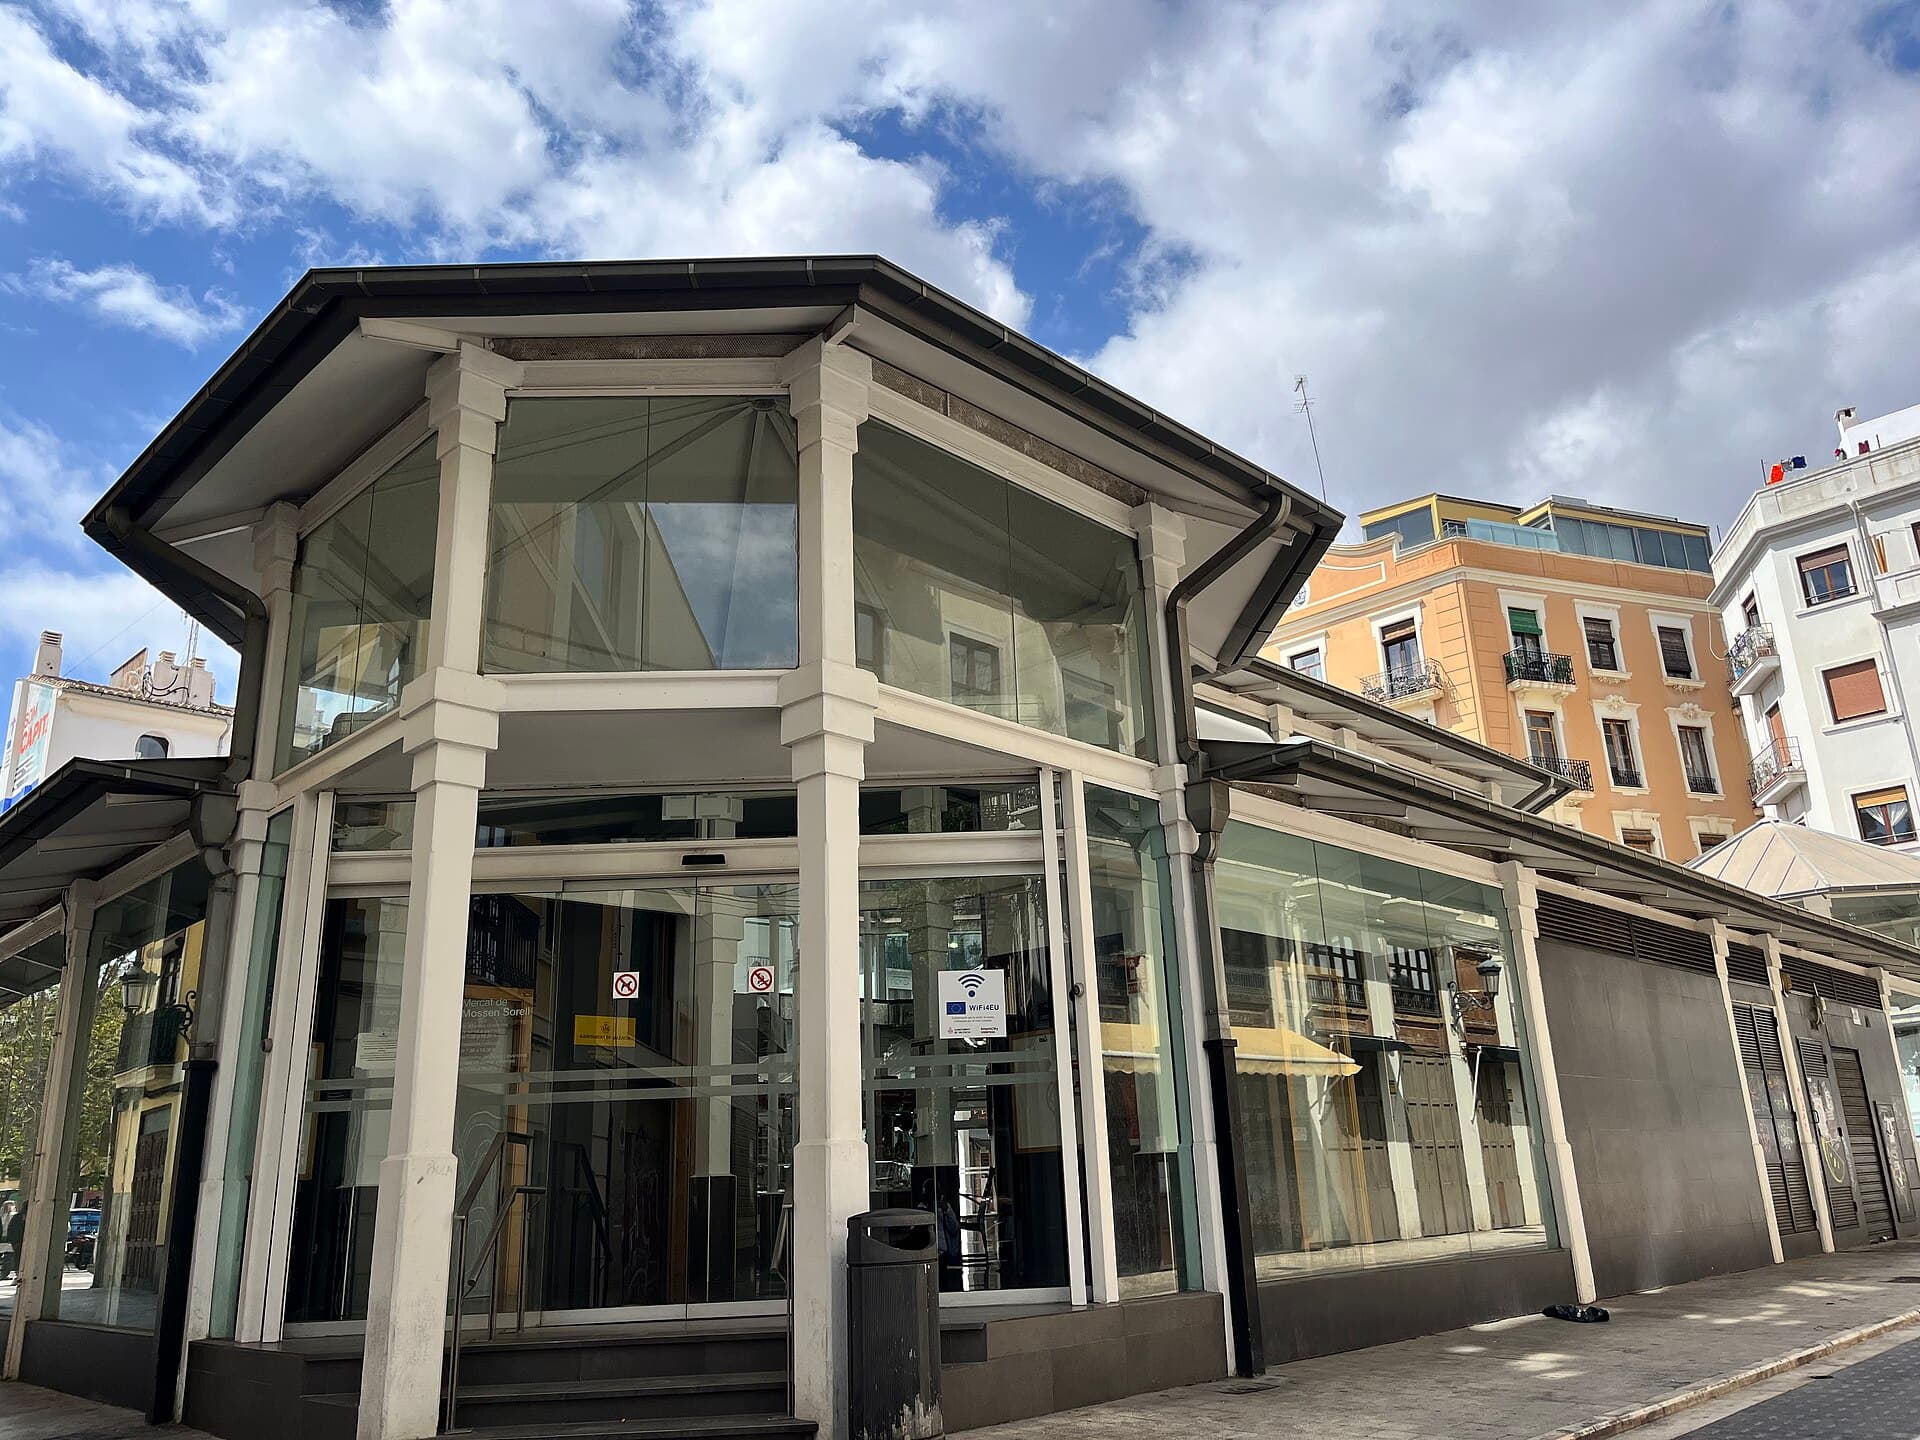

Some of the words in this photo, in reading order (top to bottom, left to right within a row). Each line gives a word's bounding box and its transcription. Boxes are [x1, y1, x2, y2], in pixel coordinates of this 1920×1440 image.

[464, 998, 493, 1008] Mercat
[496, 998, 508, 1007] de
[503, 1006, 530, 1017] Sorell
